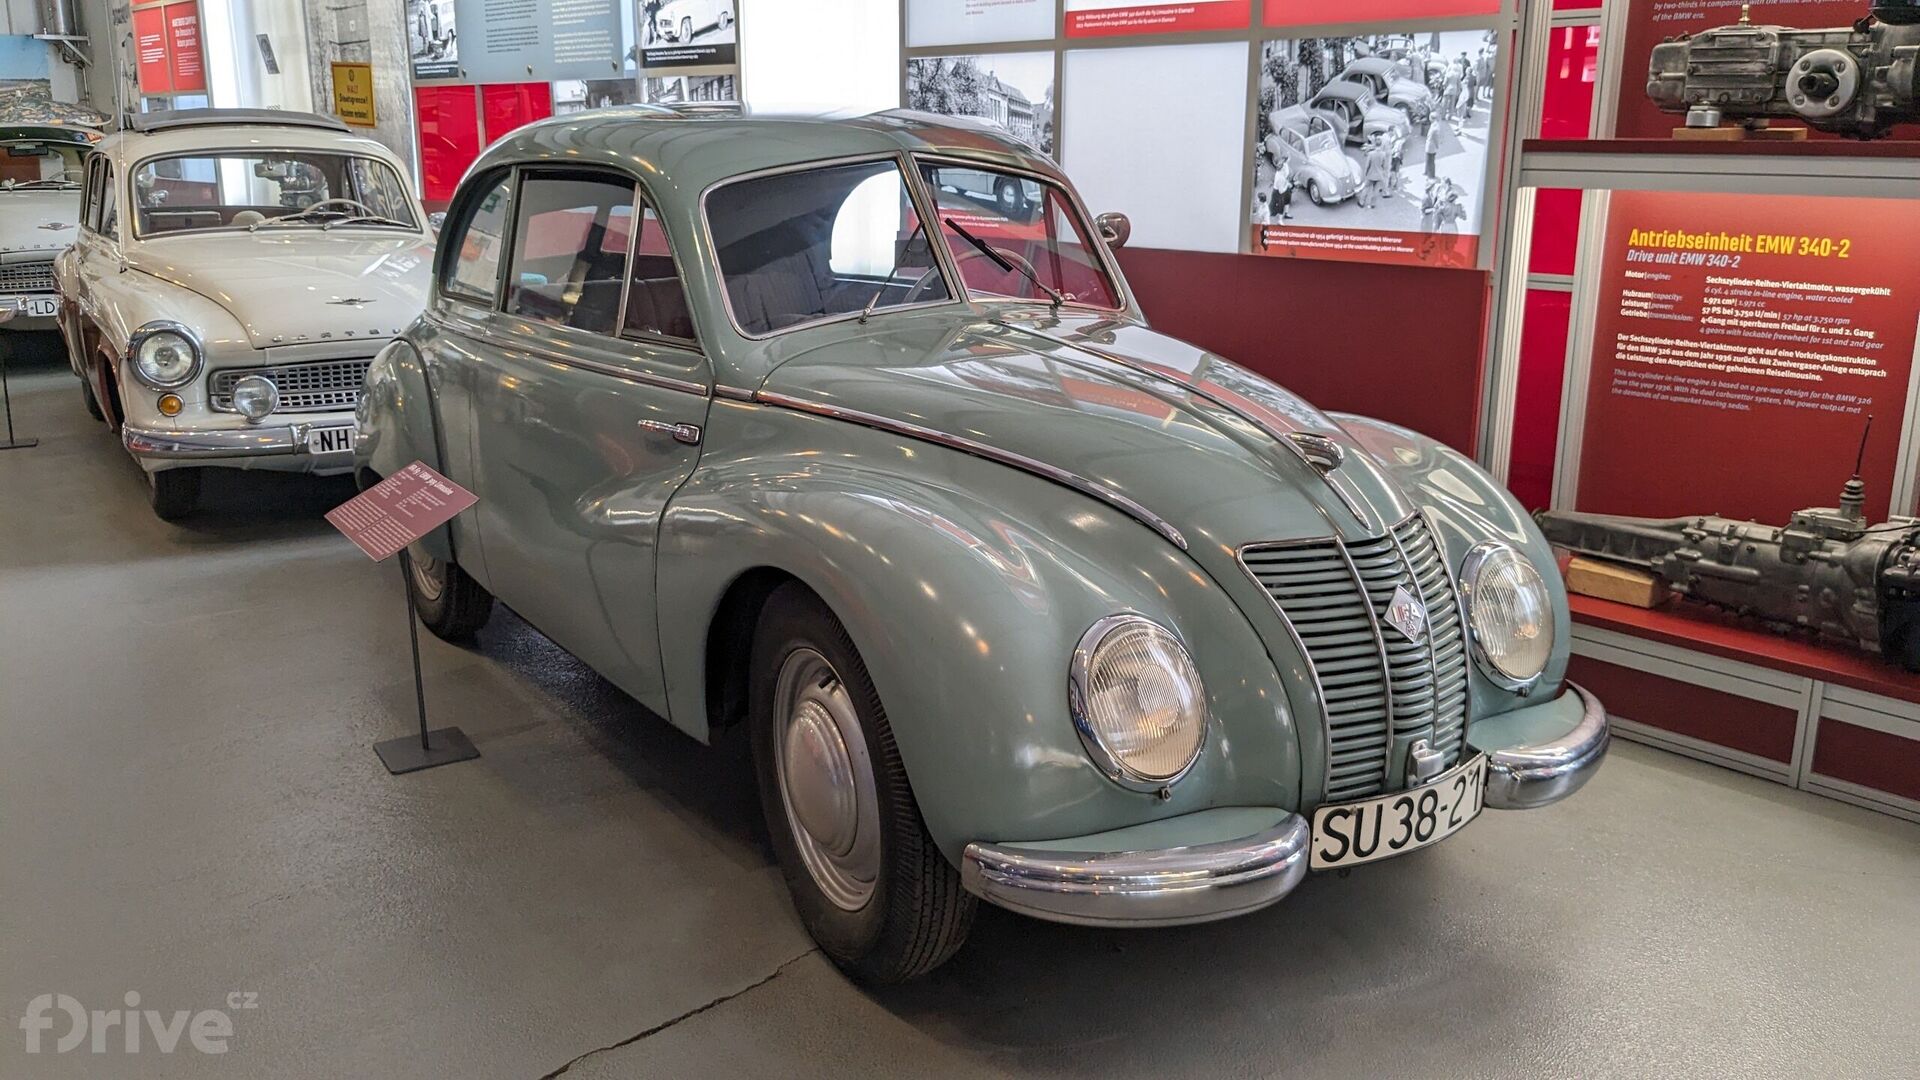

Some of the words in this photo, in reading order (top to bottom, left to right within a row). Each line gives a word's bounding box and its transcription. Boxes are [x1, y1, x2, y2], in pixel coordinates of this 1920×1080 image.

[1654, 3, 1662, 11] by
[1663, 0, 1697, 9] two-thirds
[1673, 12, 1691, 20] BMW
[1628, 228, 1752, 252] Antriebseinheit
[1755, 234, 1795, 254] EMW
[1798, 236, 1850, 257] 340-2
[1626, 249, 1656, 262] Drive
[1655, 251, 1678, 264] unit
[1678, 252, 1705, 265] EMW
[1706, 254, 1740, 268] 340-2
[1705, 275, 1833, 292] Sechszylinder-Reihen-Viertaktmotor,
[1834, 284, 1890, 296] wassergekühlt
[1730, 287, 1752, 297] stroke
[1777, 290, 1803, 300] engine,
[1805, 292, 1826, 302] water
[1827, 294, 1853, 304] cooled
[35, 301, 55, 314] LD
[1702, 296, 1720, 304] 1.971
[1701, 305, 1710, 314] 57
[1711, 306, 1721, 315] PS
[1721, 307, 1733, 316] bei
[1734, 308, 1753, 317] 3.750
[1792, 313, 1802, 321] hp
[1803, 314, 1811, 322] at
[1834, 316, 1850, 325] rpm
[1700, 315, 1726, 325] 4-Gang
[1726, 318, 1738, 326] mit
[1739, 319, 1779, 330] sperrbarem
[1780, 322, 1807, 332] Freilauf
[1809, 324, 1819, 333] für
[1820, 325, 1827, 334] 1.
[1828, 326, 1842, 335] und
[1844, 327, 1852, 336] 2.
[1853, 328, 1874, 338] Gang
[1705, 326, 1724, 335] gears
[1726, 328, 1741, 337] with
[1772, 332, 1808, 343] freewheel
[1809, 335, 1820, 344] for
[1822, 336, 1832, 345] 1st
[1833, 337, 1848, 346] and
[1849, 339, 1864, 348] 2nd
[1865, 340, 1883, 350] gear
[1616, 343, 1625, 351] für
[1626, 344, 1639, 353] den
[1639, 345, 1657, 354] BMW
[1657, 347, 1670, 356] 326
[1671, 348, 1683, 357] aus
[1684, 350, 1699, 359] dem
[1699, 351, 1713, 360] Jahr
[1714, 353, 1731, 362] 1936
[1732, 354, 1758, 365] zurück.
[1758, 357, 1771, 366] Mit
[1848, 366, 1886, 378] entsprach
[1617, 333, 1628, 342] Der
[1629, 334, 1746, 353] Sechszylinder-Reihen-Viertaktmotor
[1747, 345, 1764, 355] geht
[1764, 347, 1777, 356] auf
[1777, 348, 1793, 358] eine
[1794, 350, 1876, 366] Vorkriegskonstruktion
[1614, 352, 1626, 361] die
[1626, 353, 1654, 364] Leistung
[1654, 356, 1666, 365] den
[1667, 357, 1706, 369] Ansprüchen
[1707, 362, 1725, 371] einer
[1725, 363, 1764, 375] gehobenen
[1765, 367, 1823, 382] Reiselimousine.
[320, 429, 349, 452] NH
[1320, 804, 1383, 862] SU
[1388, 764, 1482, 850] 38-21
